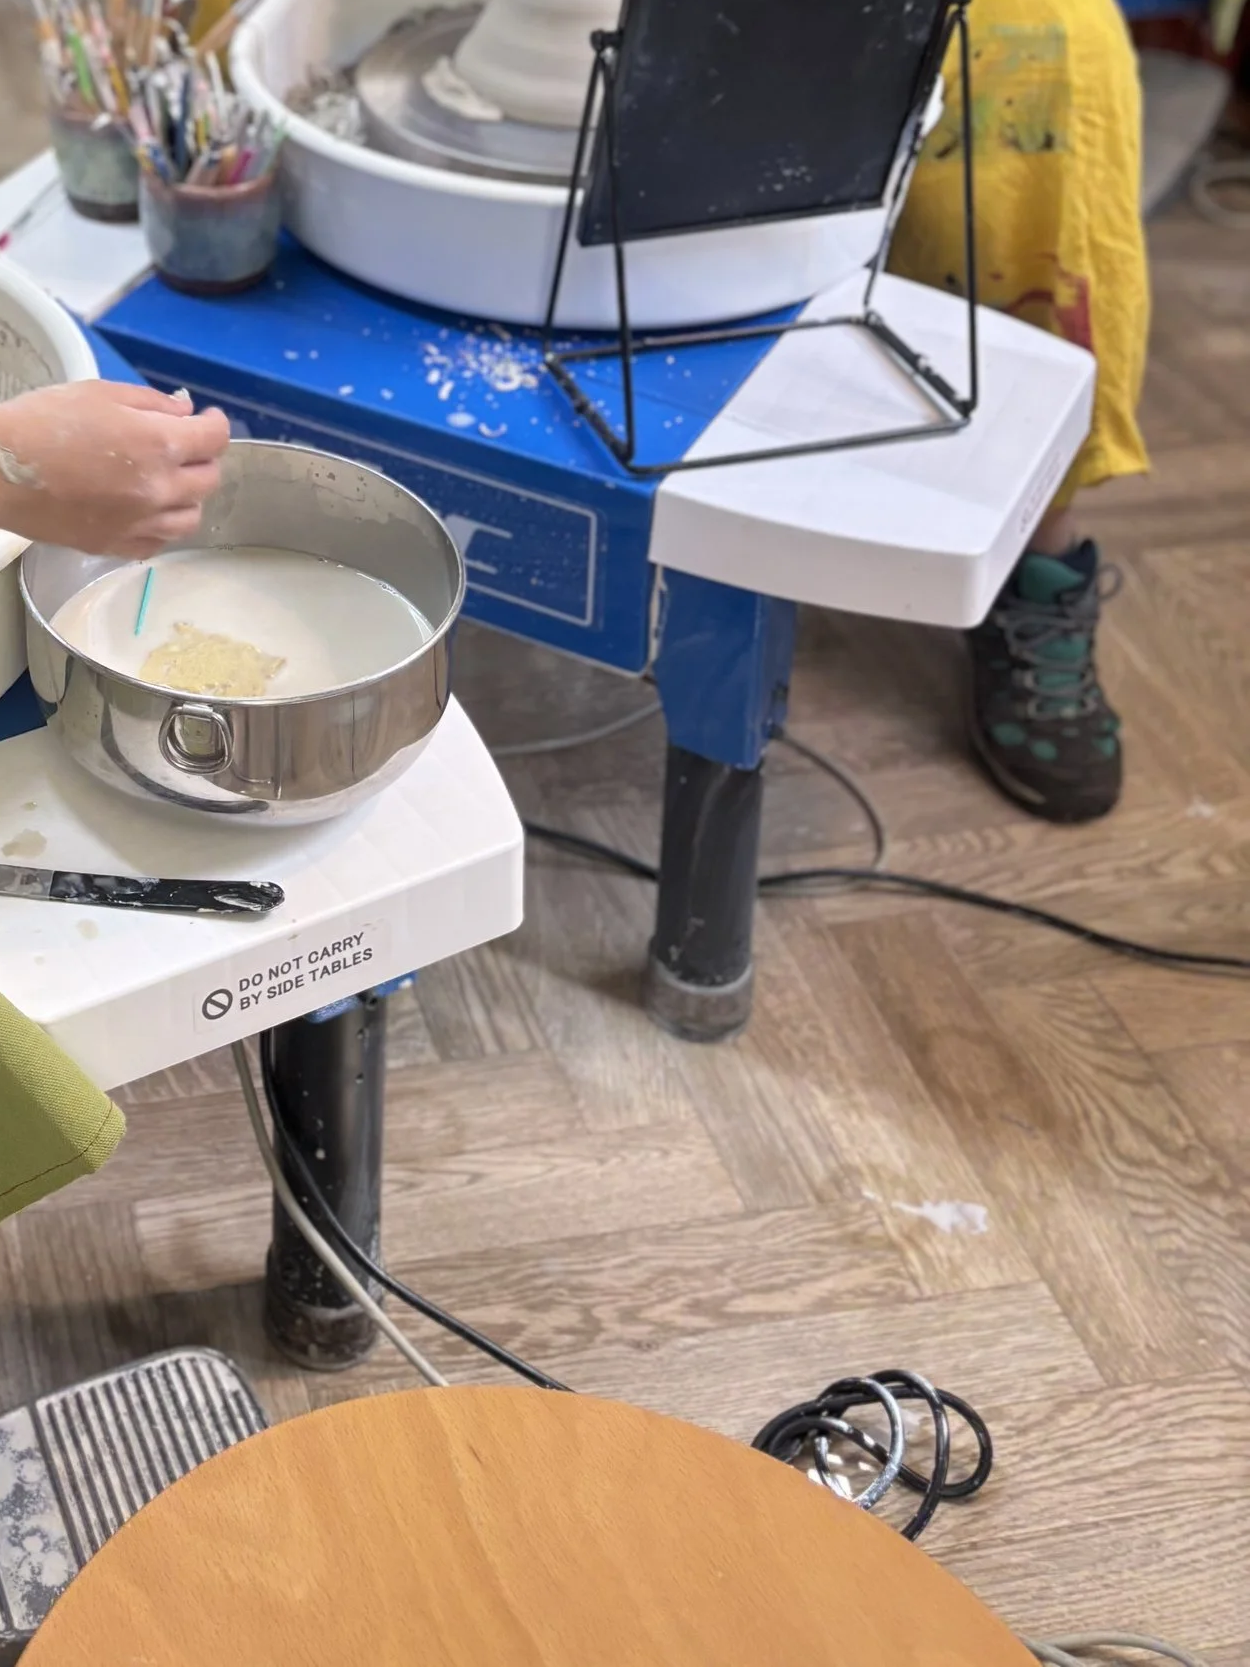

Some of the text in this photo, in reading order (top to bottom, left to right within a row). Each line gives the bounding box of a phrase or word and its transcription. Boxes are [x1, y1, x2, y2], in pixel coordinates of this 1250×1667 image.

[239, 932, 364, 991] DO NOT CARRY
[240, 948, 373, 1010] BY SIDE TABLES
